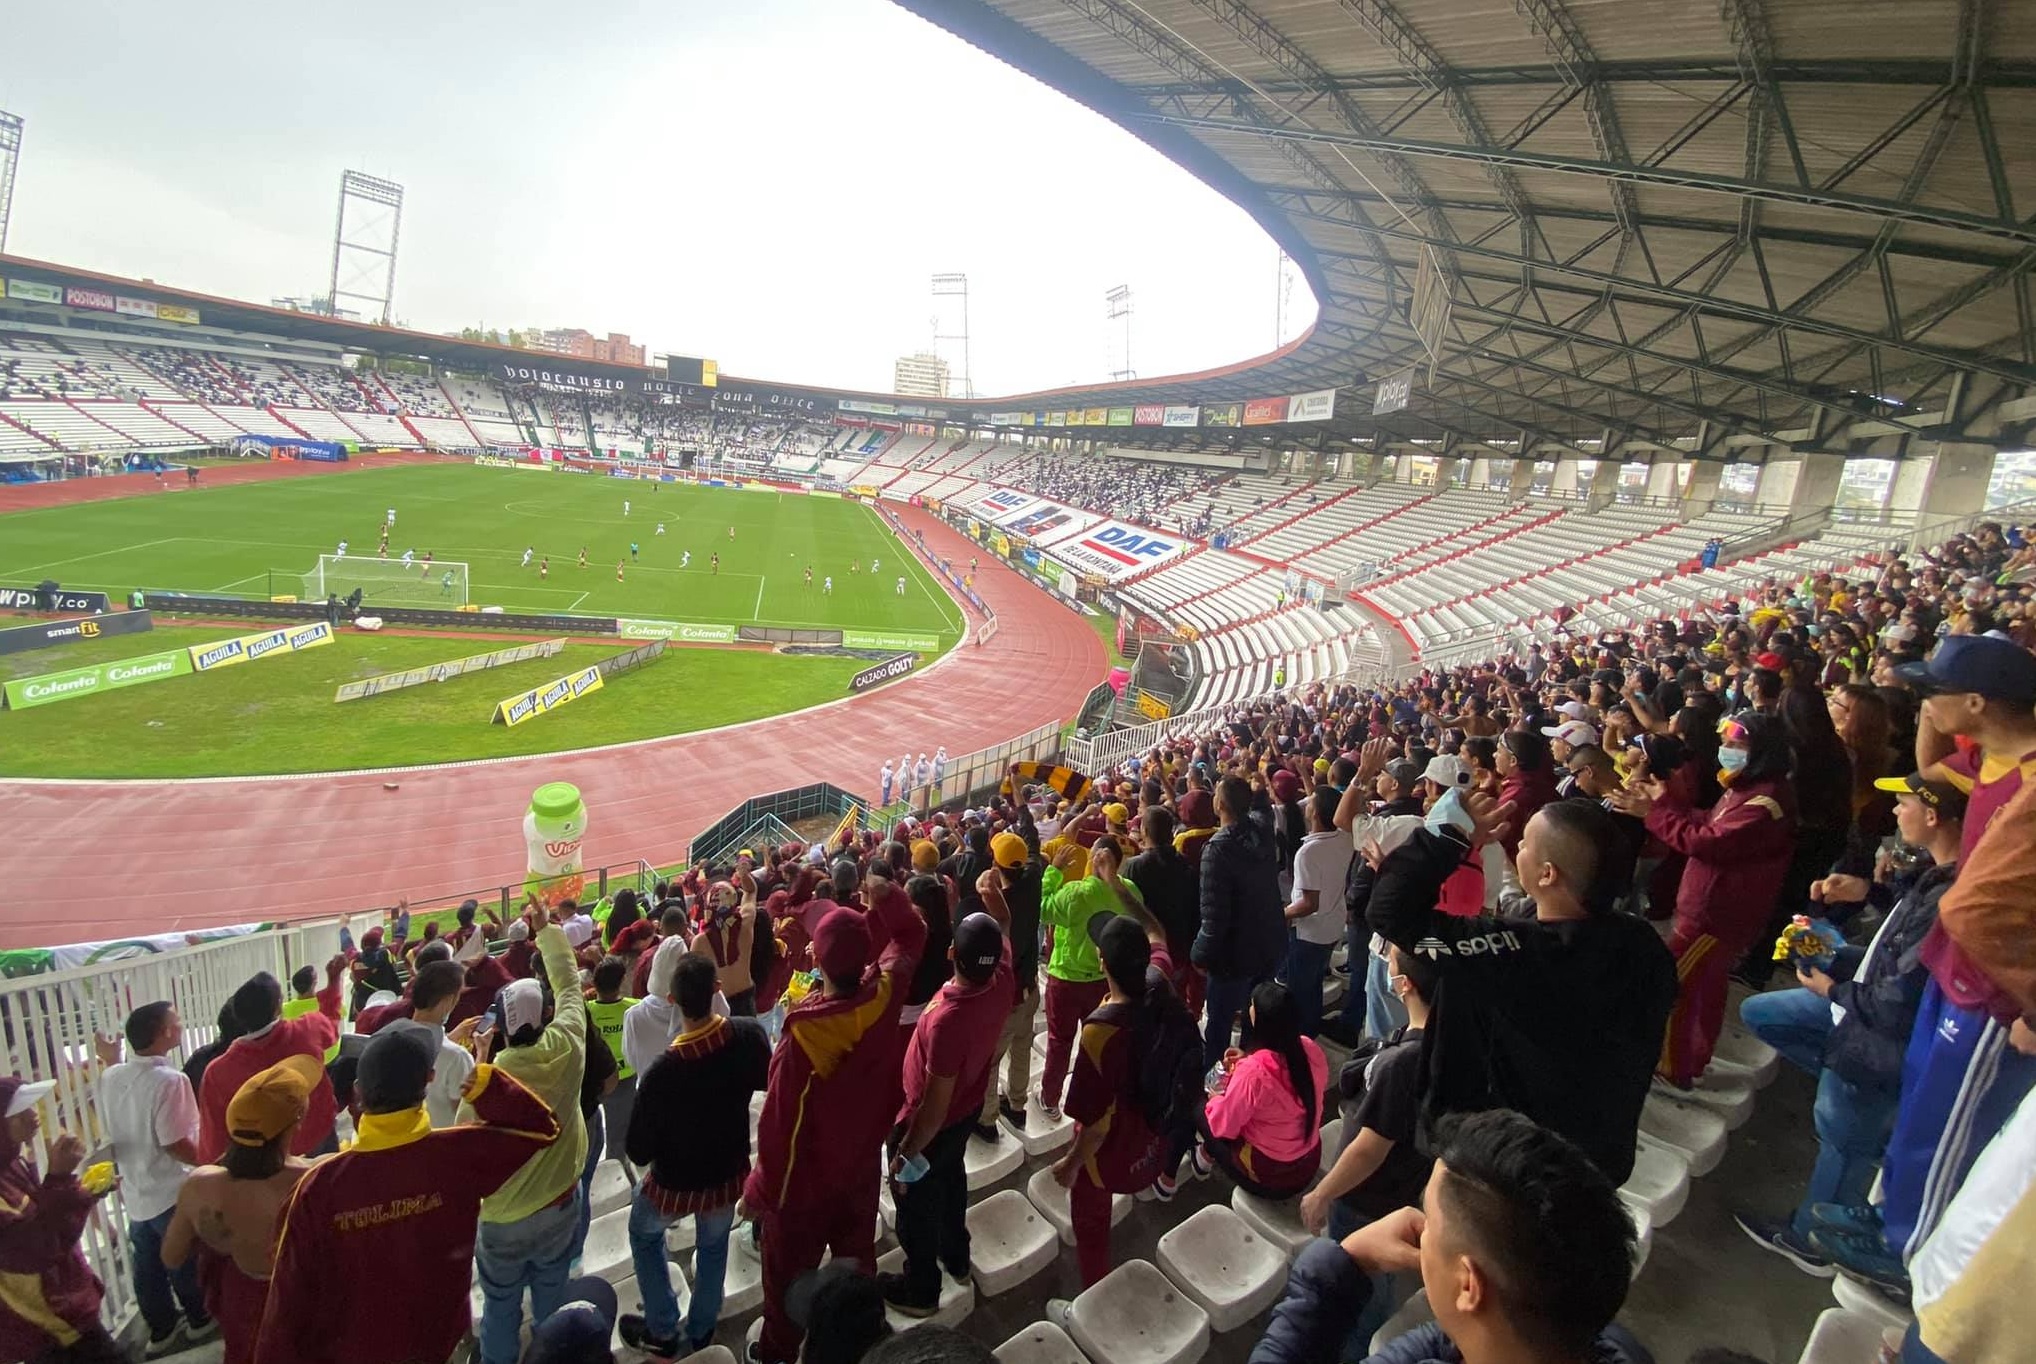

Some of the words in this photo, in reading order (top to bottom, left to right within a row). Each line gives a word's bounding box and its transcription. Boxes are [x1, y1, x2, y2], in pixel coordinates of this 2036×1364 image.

[67, 288, 113, 309] POSTOBON
[990, 491, 1028, 507] DAF
[1093, 526, 1174, 557] DAF
[626, 625, 672, 637] Colanta
[682, 628, 727, 639] Colanta
[109, 658, 173, 682] Colanta
[856, 669, 887, 687] CALZADO
[888, 656, 913, 676] GOLTY
[25, 674, 96, 699] Colanta
[335, 1191, 443, 1231] TOLIMA
